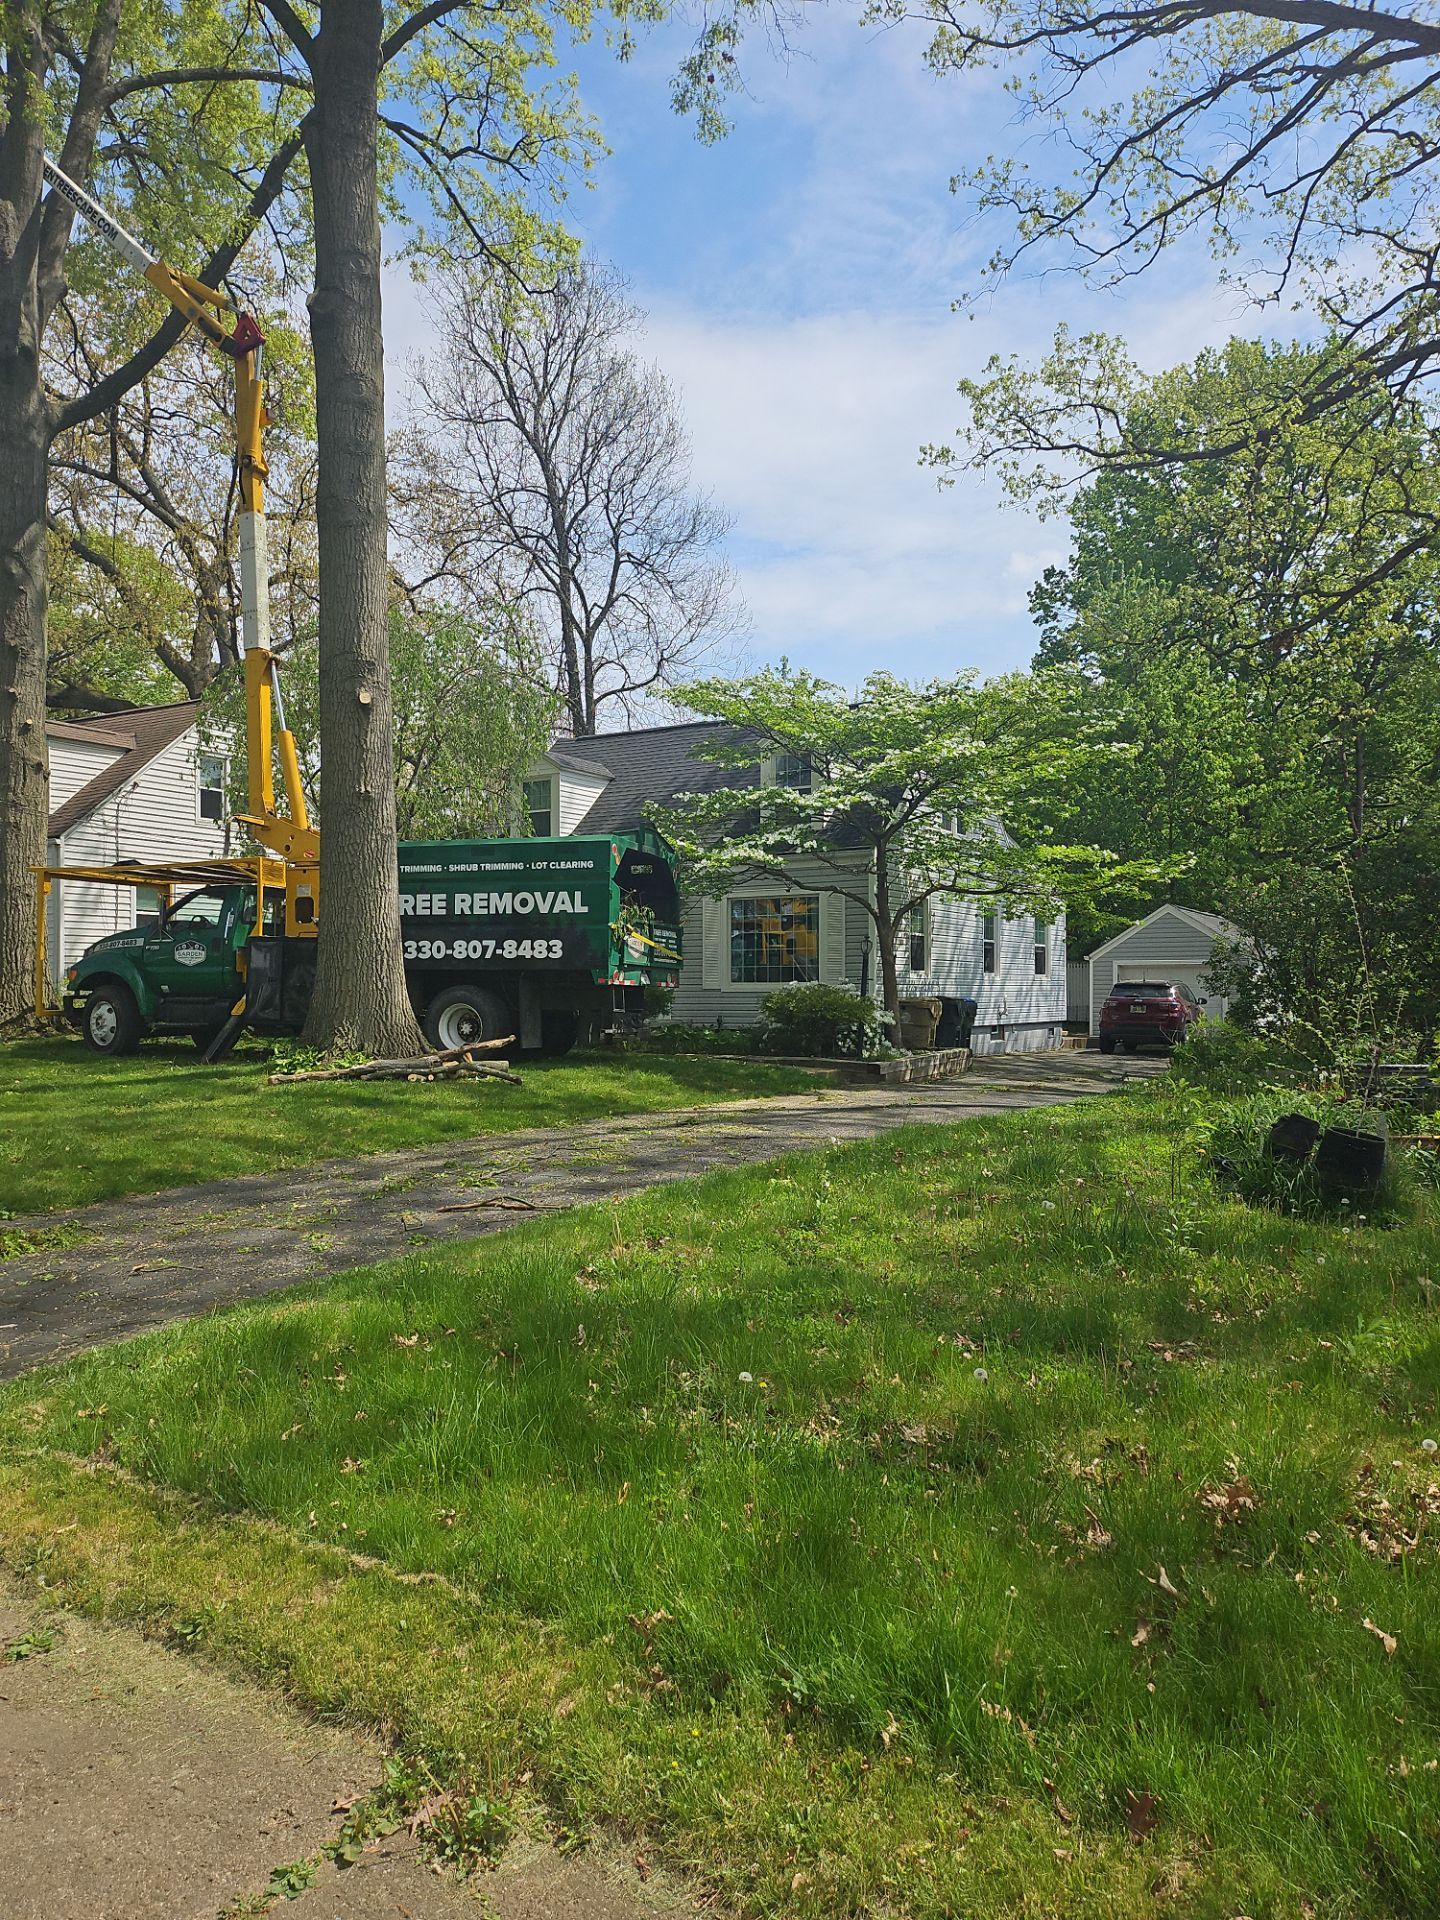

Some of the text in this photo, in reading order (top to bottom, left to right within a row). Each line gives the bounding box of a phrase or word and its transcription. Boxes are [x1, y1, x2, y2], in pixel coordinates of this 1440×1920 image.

[43, 163, 119, 241] ENTREESCAPE.COM
[399, 860, 594, 873] TRIMMING SHRUB TRIMMING LOT CLEARING
[398, 890, 589, 916] REE REMOVAL
[403, 939, 563, 959] 330-807-8483
